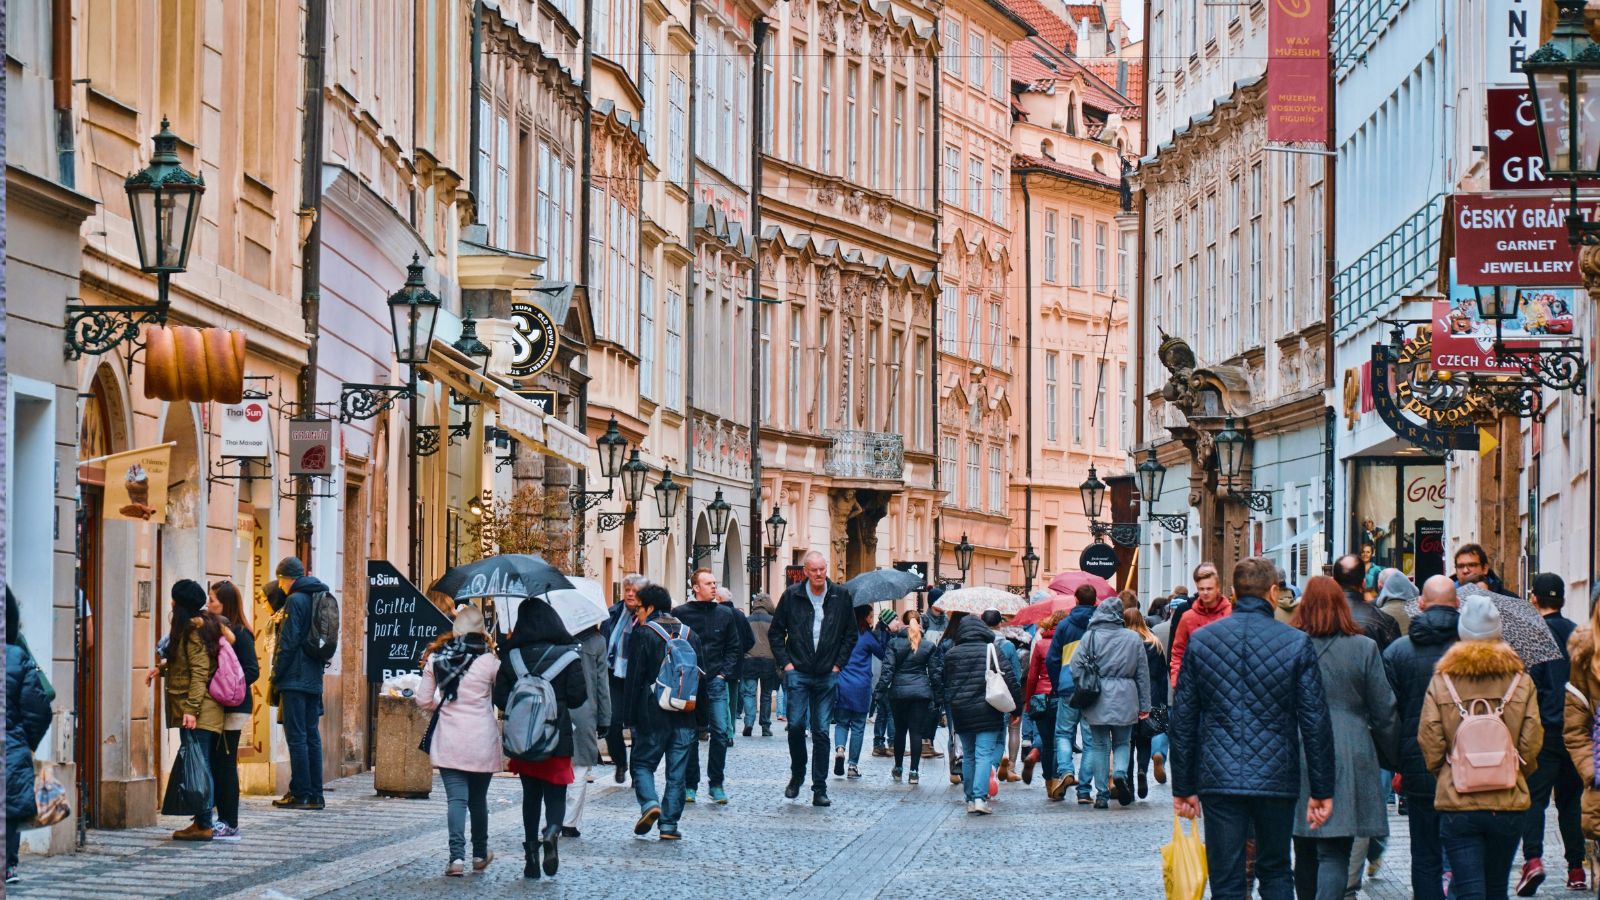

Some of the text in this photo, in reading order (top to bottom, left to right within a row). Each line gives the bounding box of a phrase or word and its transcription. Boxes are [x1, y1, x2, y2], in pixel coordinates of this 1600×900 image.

[1286, 37, 1310, 45] WAX
[1508, 0, 1527, 73] NÉ
[1275, 48, 1320, 56] MUSEUM
[1460, 204, 1592, 229] ČESKÝ GRÁNT
[1496, 240, 1557, 251] GARNET
[1480, 261, 1573, 273] JEWELLERY
[546, 325, 554, 346] TOWN
[1437, 355, 1479, 367] CZECH
[246, 409, 262, 417] Sun
[375, 597, 415, 614] Grilled
[374, 618, 438, 641] pork knee
